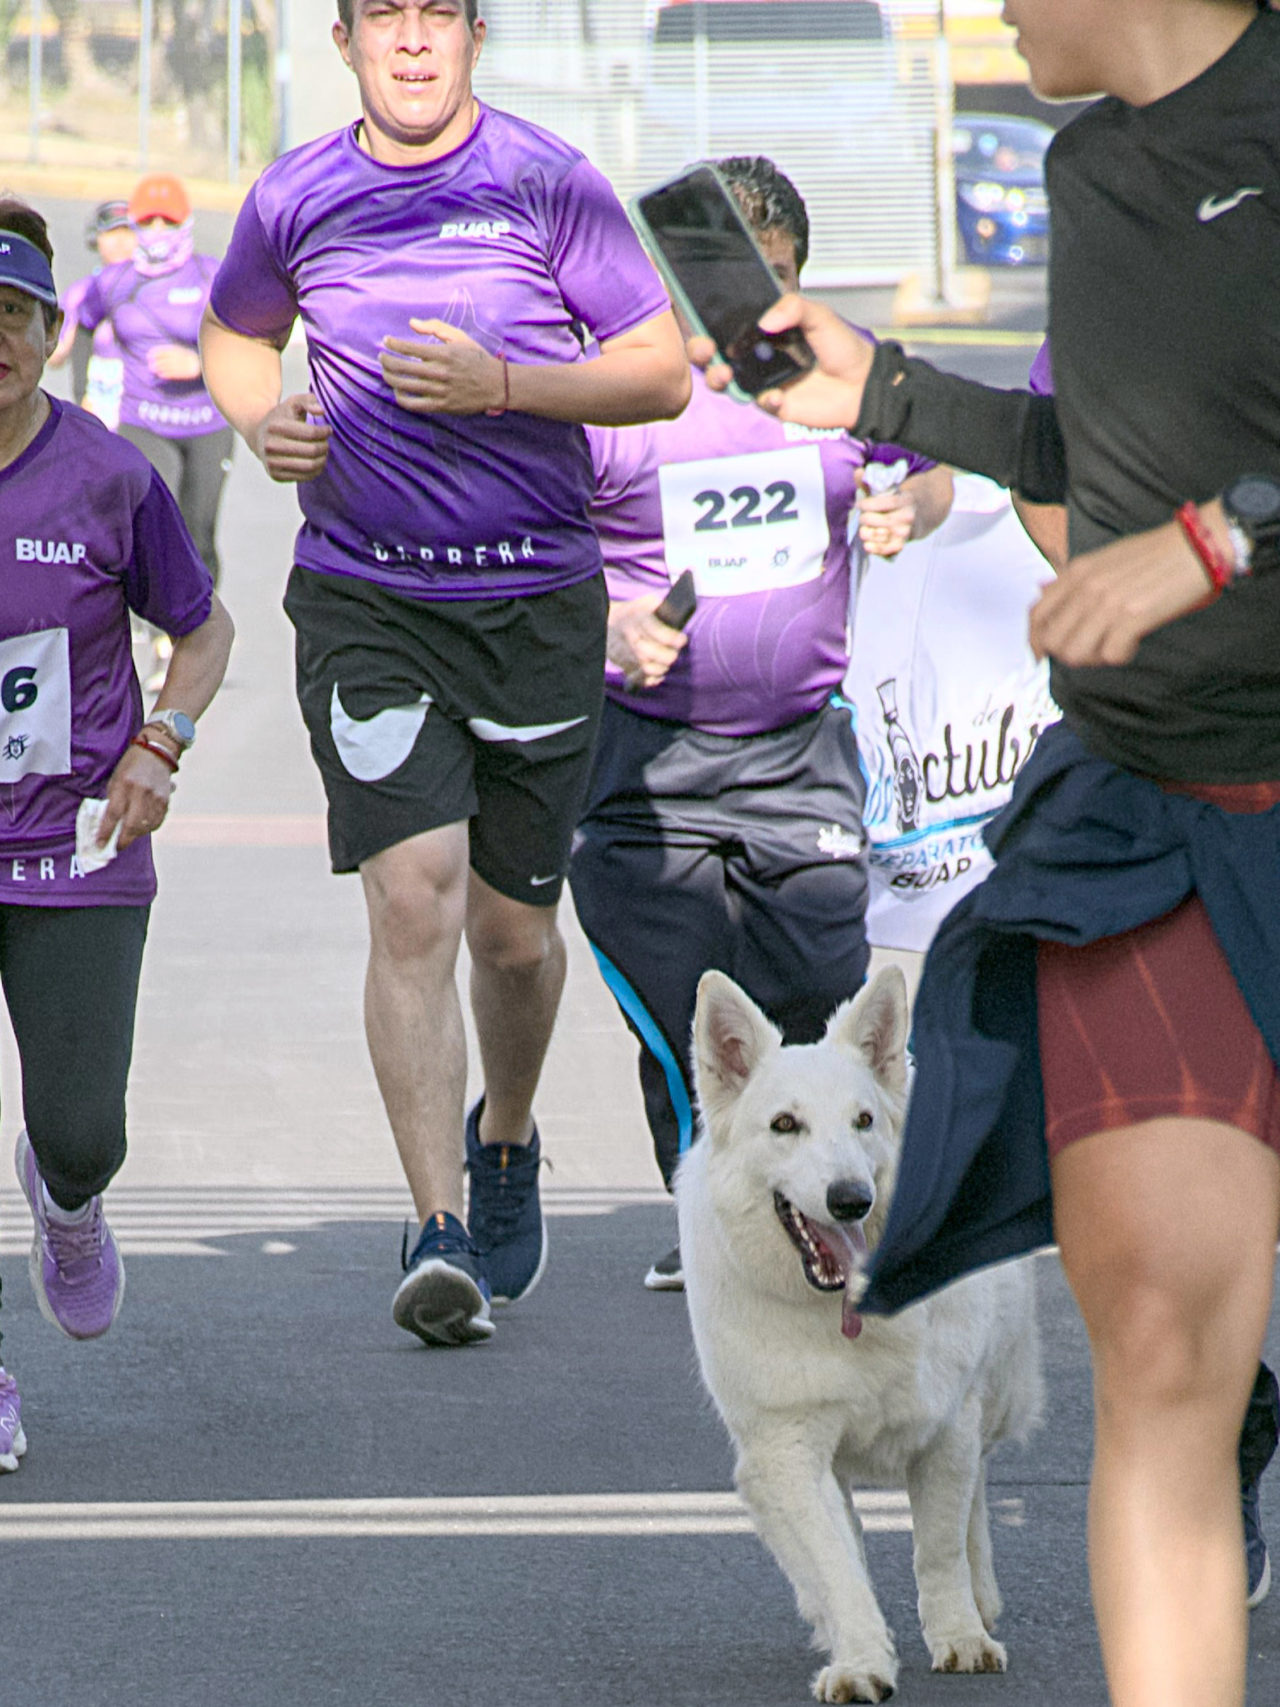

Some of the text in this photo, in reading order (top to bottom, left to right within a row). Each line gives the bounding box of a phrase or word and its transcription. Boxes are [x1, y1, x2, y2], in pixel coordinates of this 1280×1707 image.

[439, 221, 510, 240] BUAP
[693, 480, 799, 533] 222
[15, 537, 87, 565] BUAP
[890, 857, 972, 890] BUAP
